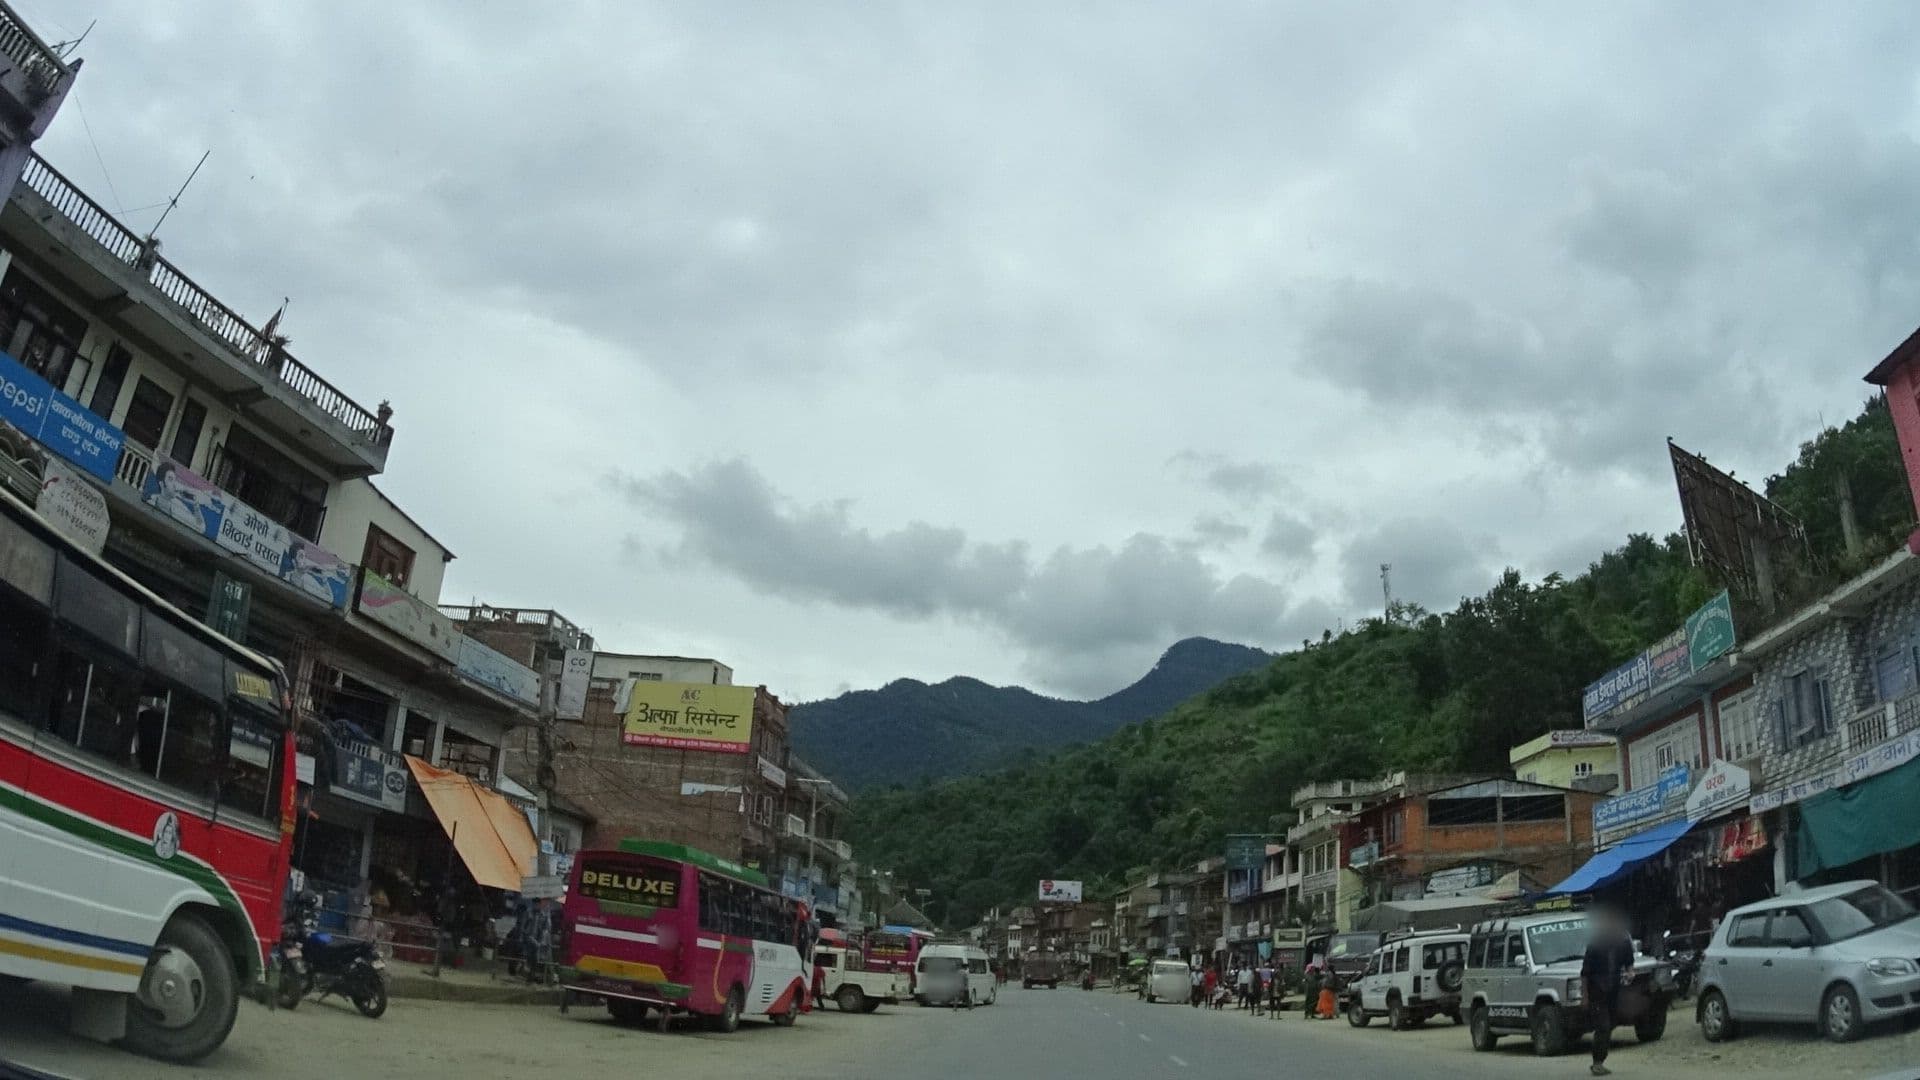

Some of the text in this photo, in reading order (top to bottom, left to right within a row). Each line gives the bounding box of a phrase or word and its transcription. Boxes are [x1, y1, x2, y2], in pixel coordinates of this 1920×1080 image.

[254, 541, 281, 566] पसल
[637, 702, 740, 729] अल्फा सिमेन्ट
[582, 870, 675, 896] DELUXE
[1531, 922, 1570, 935] LOVE
